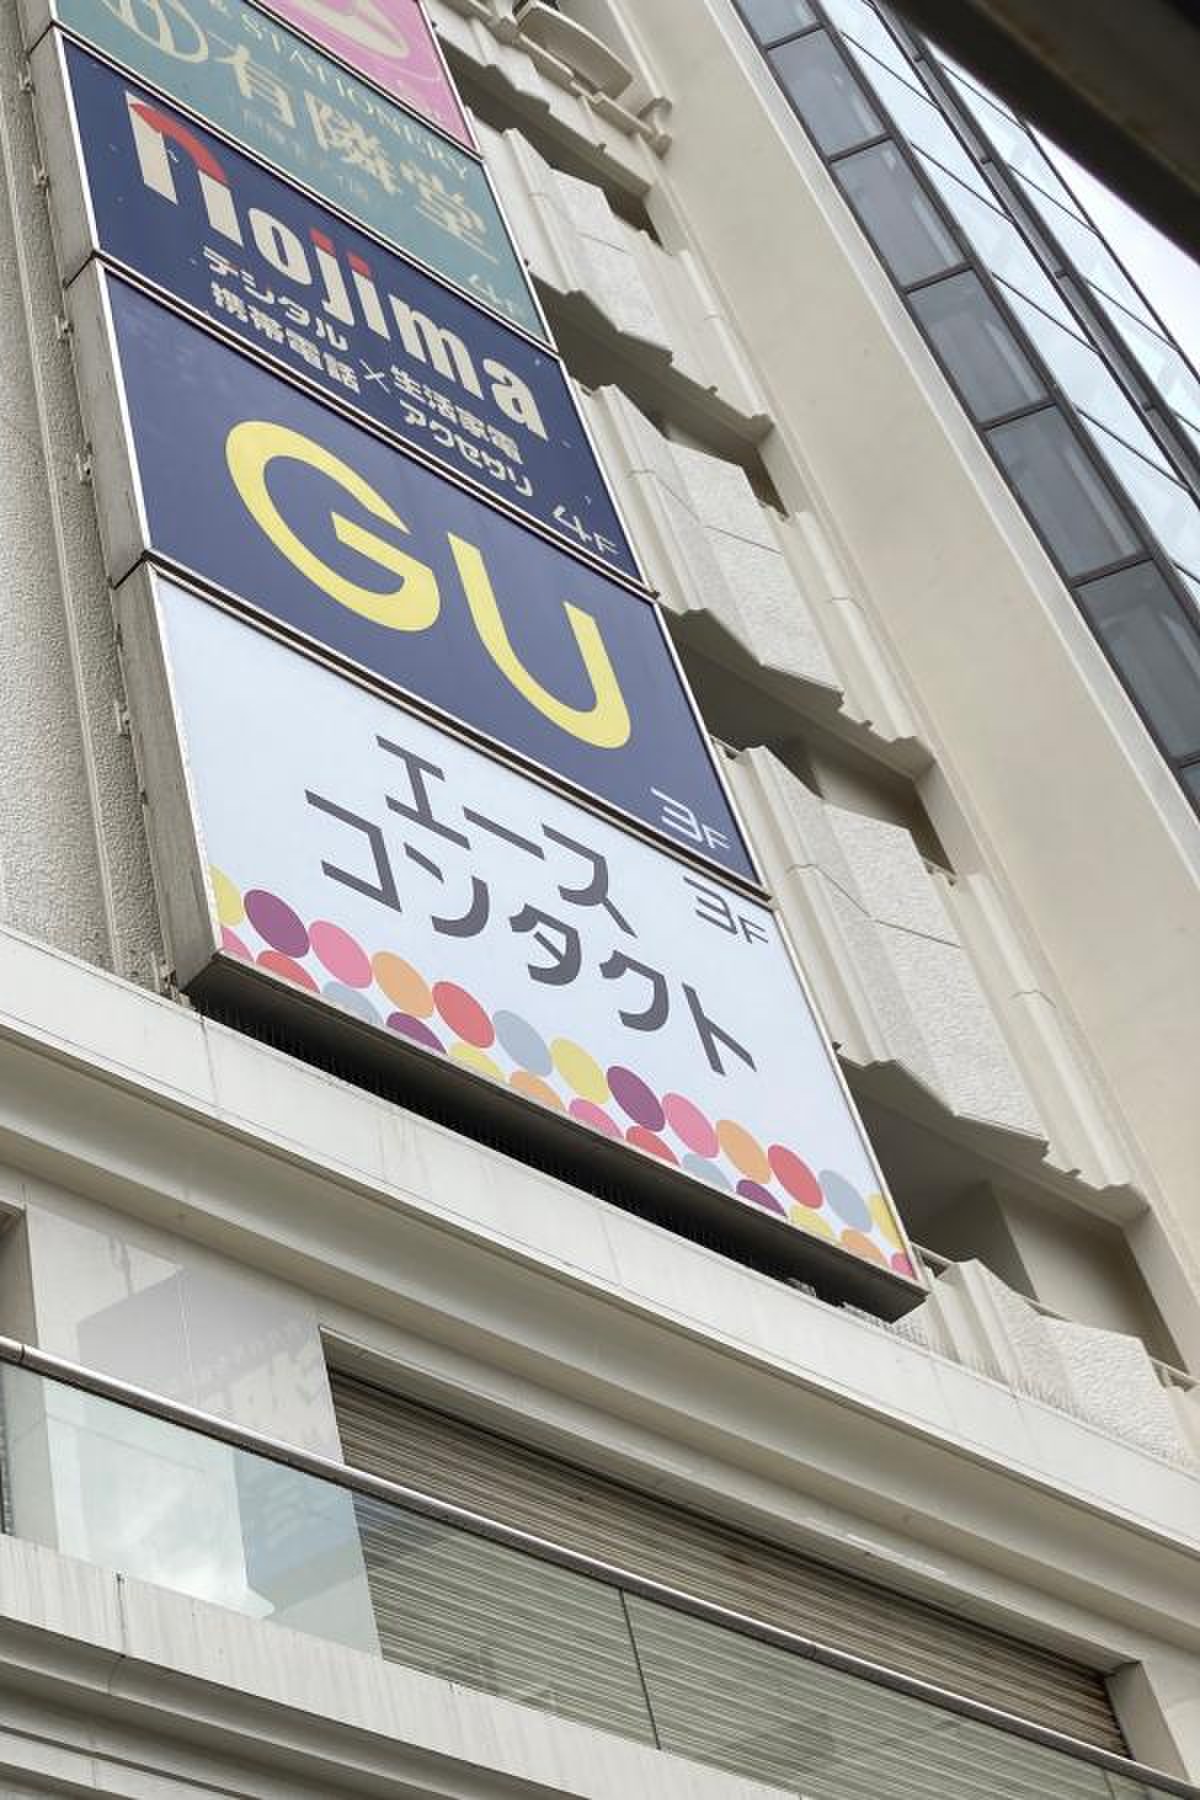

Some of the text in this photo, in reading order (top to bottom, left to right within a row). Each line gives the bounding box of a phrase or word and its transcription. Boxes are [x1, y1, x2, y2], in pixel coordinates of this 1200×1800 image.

[212, 42, 498, 264] 有隣堂
[124, 89, 548, 440] nojima
[209, 280, 361, 394] 携帯電話
[390, 365, 524, 465] 生活家電
[399, 399, 535, 497] アクセサリ
[224, 420, 632, 749] GU
[552, 505, 620, 554] 4F
[375, 734, 638, 940] エース
[650, 788, 732, 853] 3F
[304, 789, 758, 1077] コンタクト
[683, 876, 770, 945] 3F
